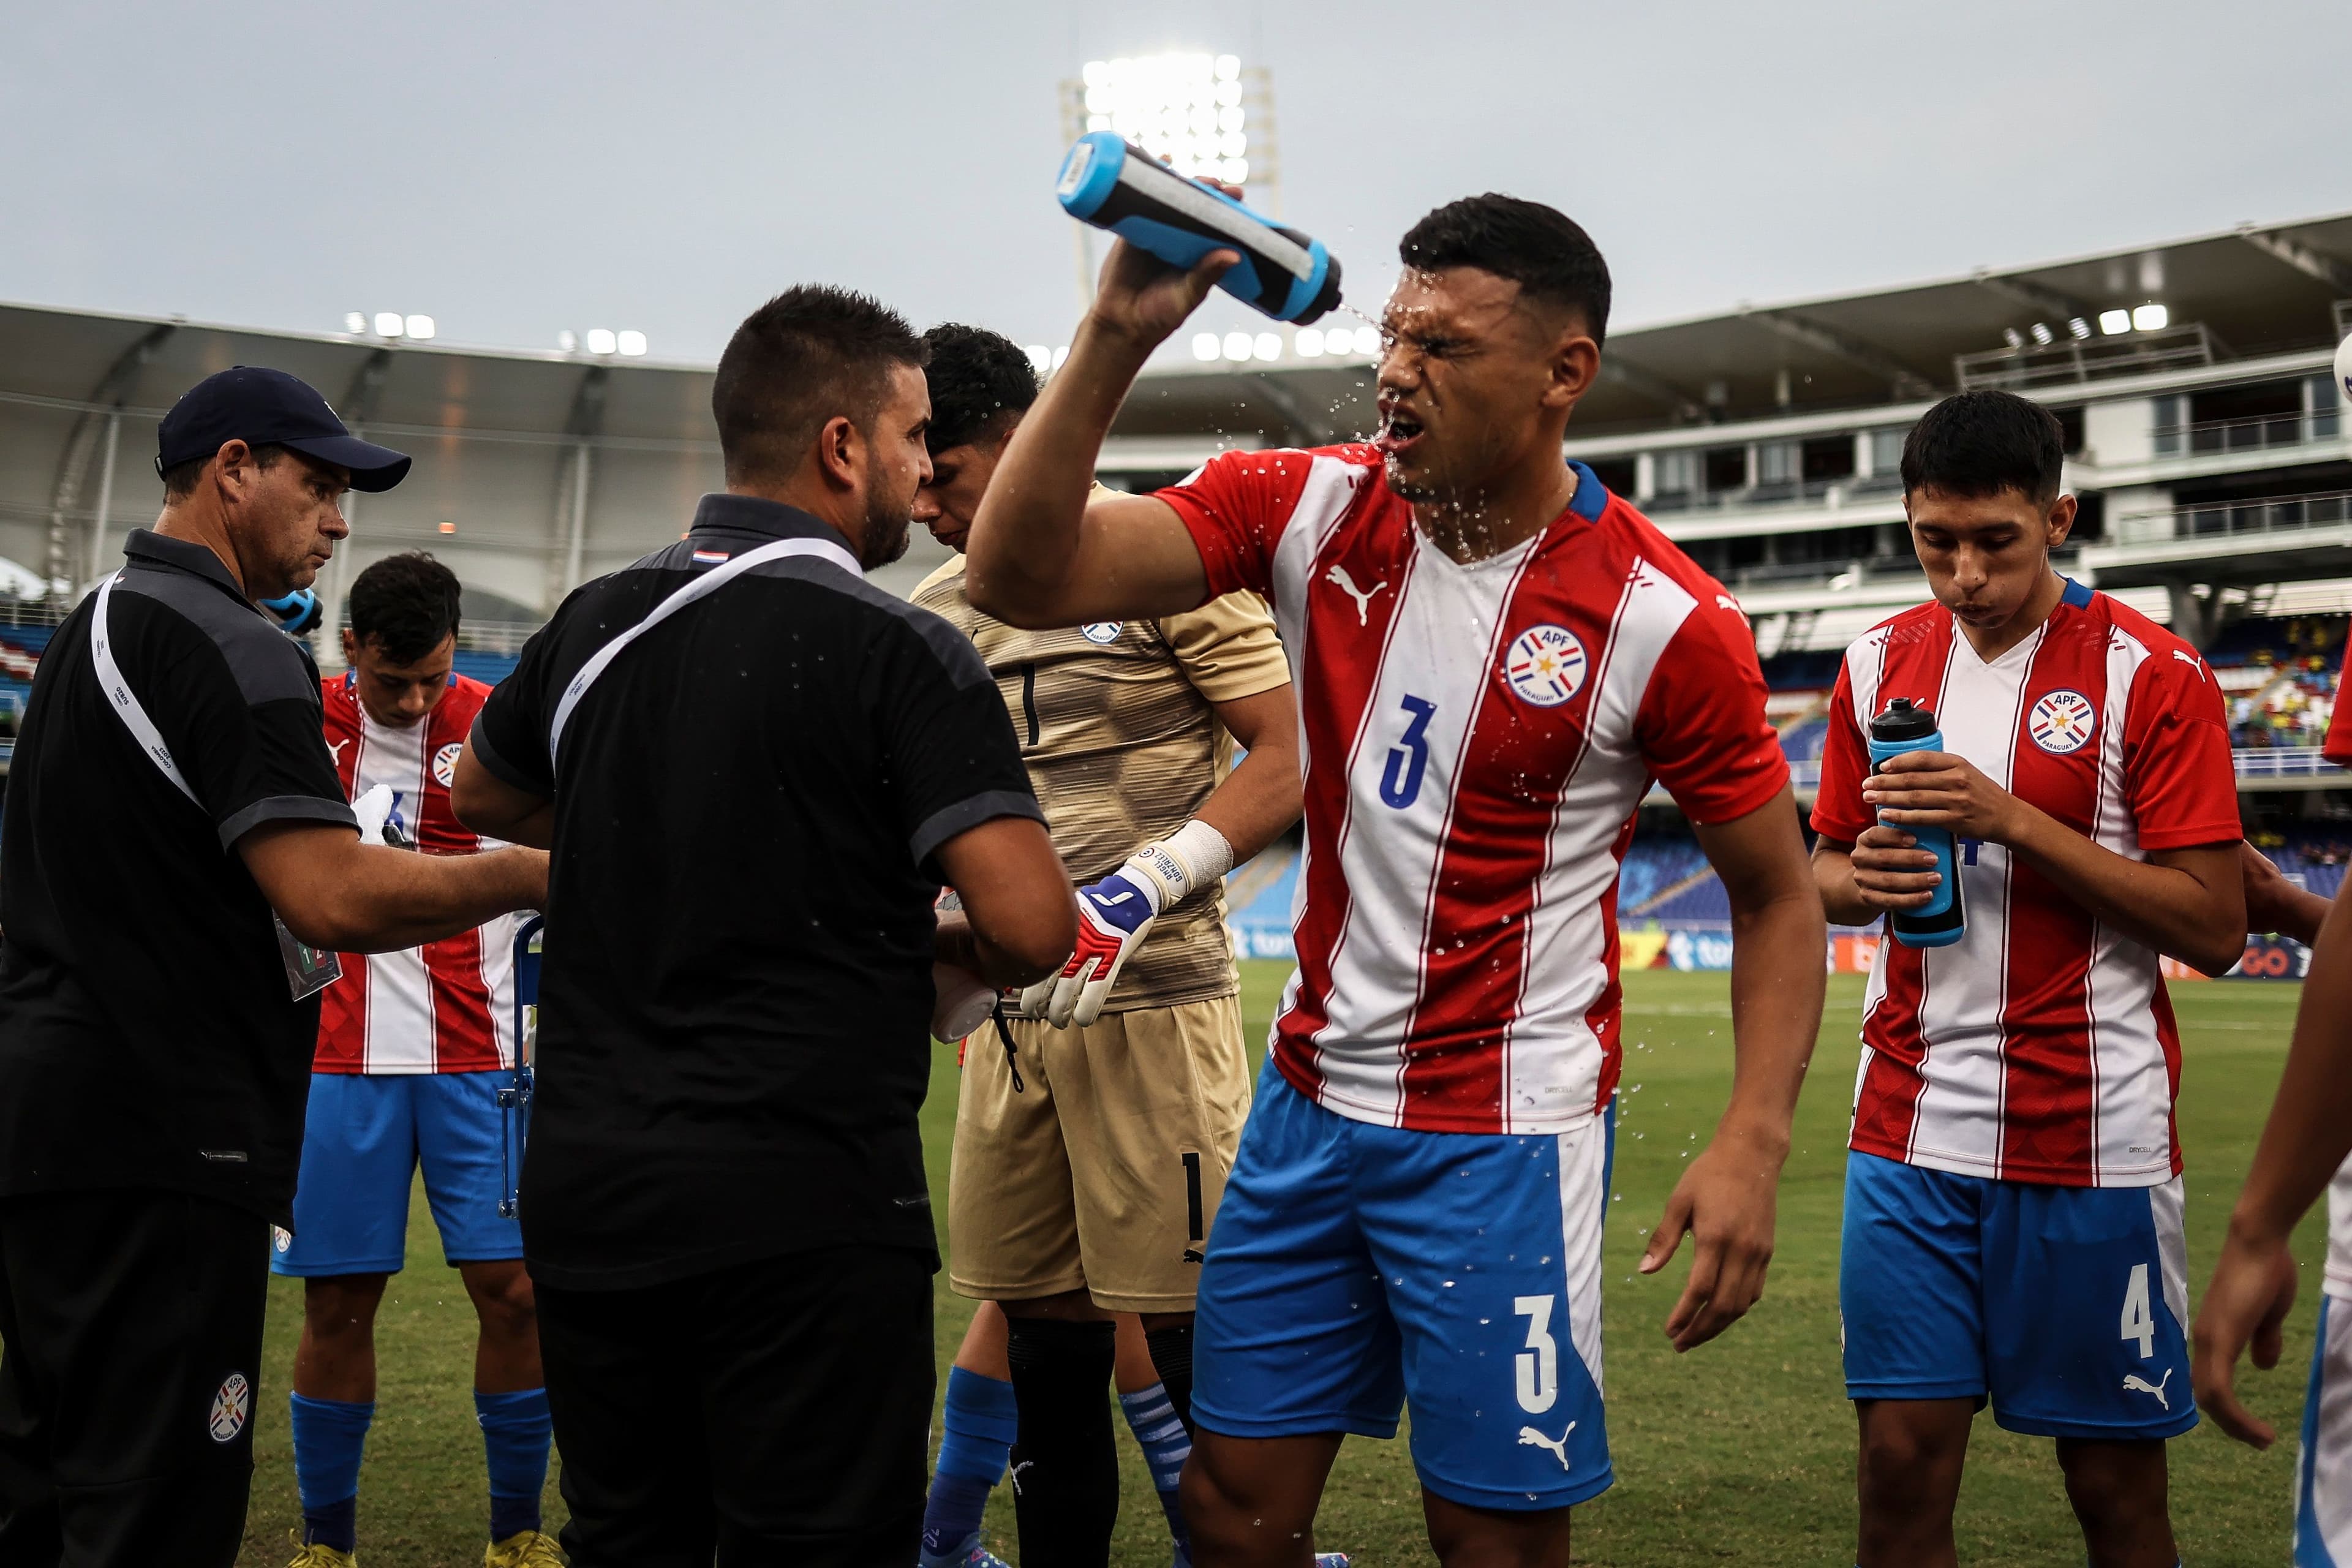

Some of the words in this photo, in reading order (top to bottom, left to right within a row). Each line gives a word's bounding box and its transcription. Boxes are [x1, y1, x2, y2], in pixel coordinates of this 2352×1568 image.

[1541, 630, 1570, 647] APF
[116, 687, 129, 706] SUB20
[1518, 685, 1555, 702] PARAGUAY
[2054, 695, 2077, 706] APF
[1021, 663, 1040, 747] 1
[159, 747, 171, 760] 2023
[1379, 693, 1438, 810] 3
[2042, 740, 2073, 750] PARAGUAY
[151, 745, 172, 769] COLOMBIA
[1154, 861, 1173, 880] ANGEL
[1155, 852, 1183, 883] GONZALEZ
[1182, 1152, 1203, 1241] 1
[2121, 1263, 2155, 1359] 4
[1515, 1294, 1557, 1414] 3
[227, 1377, 242, 1390] APF
[214, 1430, 235, 1440] PARAGUAY
